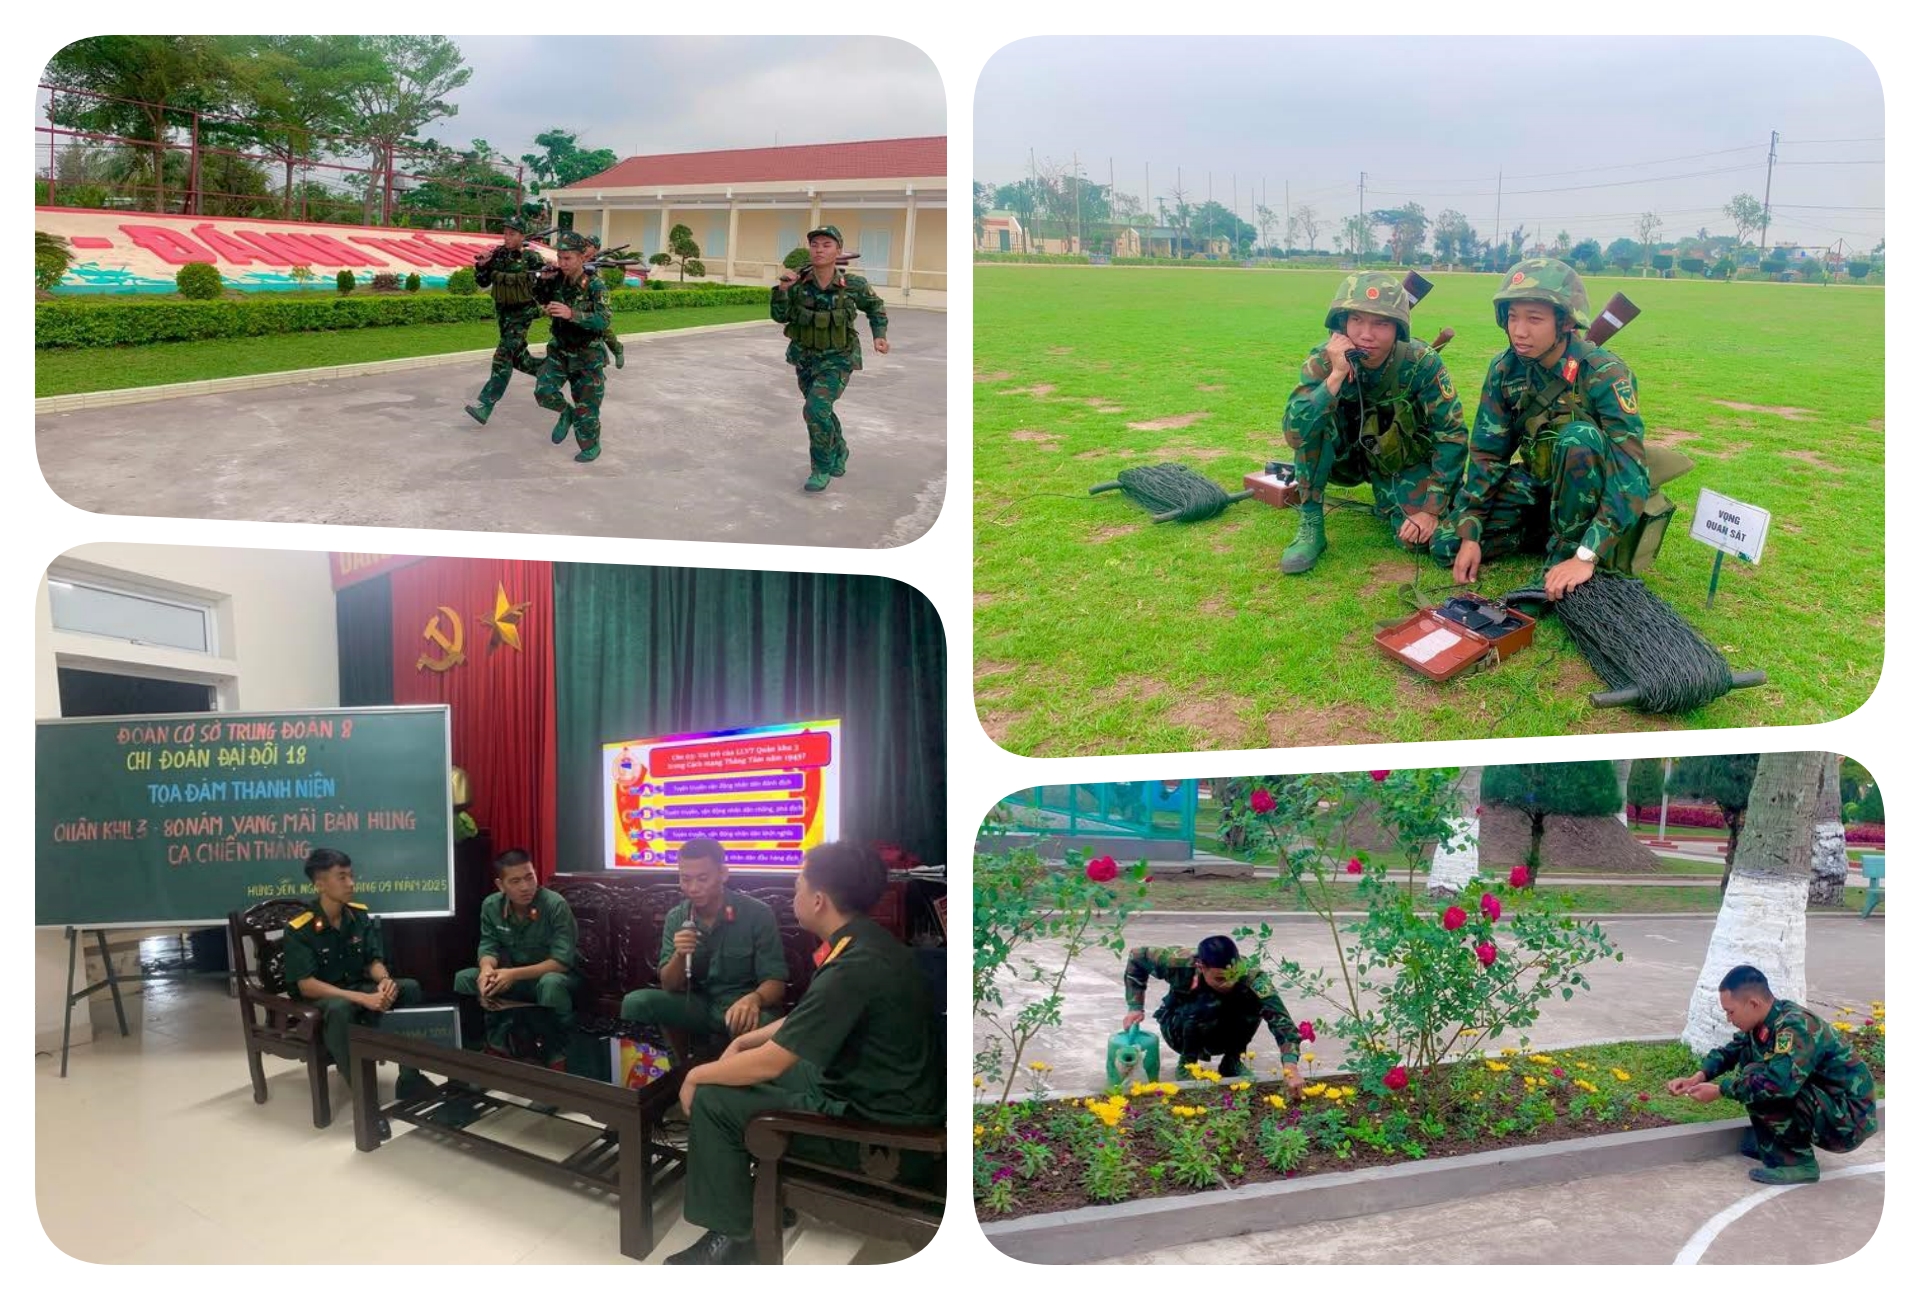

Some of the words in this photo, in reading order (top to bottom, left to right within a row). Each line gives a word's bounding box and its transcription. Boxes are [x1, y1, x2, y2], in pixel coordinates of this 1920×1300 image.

[118, 223, 390, 268] ĐÁNH
[1718, 509, 1741, 526] VỌNG
[1705, 519, 1729, 536] QUAN
[1729, 529, 1747, 542] SÁT
[227, 721, 277, 742] TRUNG
[340, 718, 353, 739] 8
[285, 745, 307, 765] 18
[231, 779, 292, 800] THANH
[295, 770, 336, 798] NIÊN
[231, 813, 279, 836] VANG
[166, 843, 194, 866] CA
